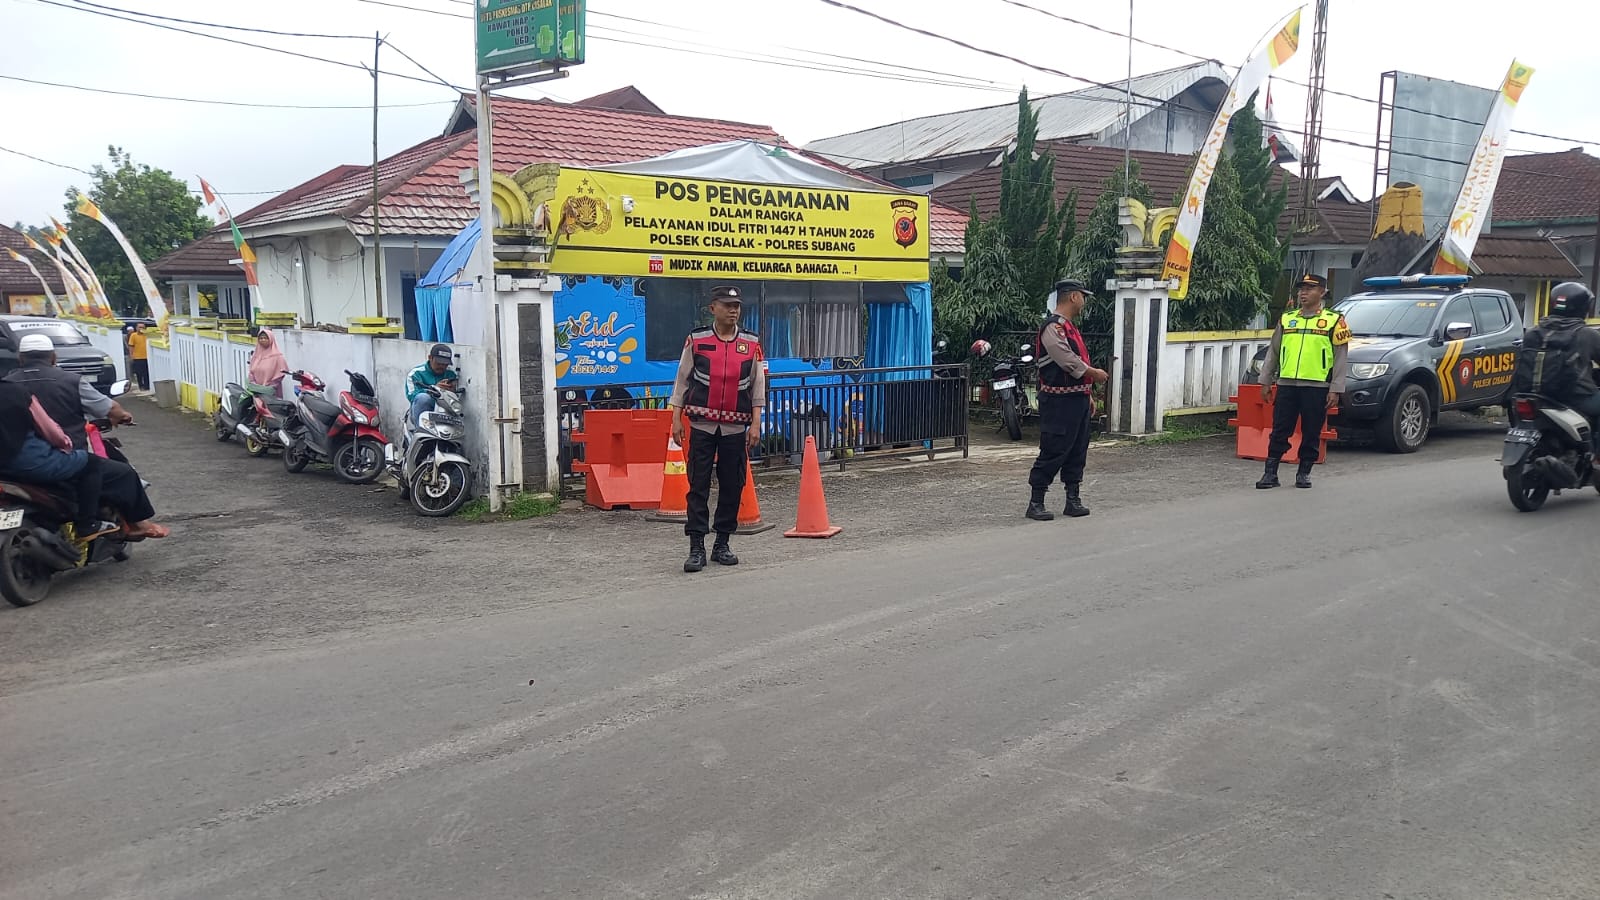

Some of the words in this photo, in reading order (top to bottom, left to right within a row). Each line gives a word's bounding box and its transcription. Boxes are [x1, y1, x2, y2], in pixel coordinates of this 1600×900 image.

[487, 20, 510, 32] RAWAT
[512, 16, 529, 26] INAP
[514, 35, 529, 46] UGD
[655, 180, 700, 202] POS
[706, 185, 850, 212] PENGAMANAN
[710, 206, 752, 220] DALAM
[755, 209, 804, 222] RANGKA
[624, 216, 704, 232] PELAYANAN
[707, 222, 736, 233] IDUL
[738, 223, 768, 235] FITRI
[770, 225, 796, 236] 1447
[798, 227, 807, 237] H
[809, 227, 847, 238] TAHUN
[849, 229, 875, 239] 2026
[650, 233, 700, 247] POLSEK
[702, 236, 755, 249] CISALAK
[765, 239, 809, 251] POLRES
[811, 241, 856, 252] SUBANG
[650, 263, 663, 271] 110
[669, 259, 704, 271] MUDIK
[707, 260, 740, 273] AMAN,
[743, 262, 793, 273] KELUARGA
[795, 263, 839, 274] BAHAGIA
[578, 311, 634, 337] Eid
[1474, 352, 1514, 376] POLISI
